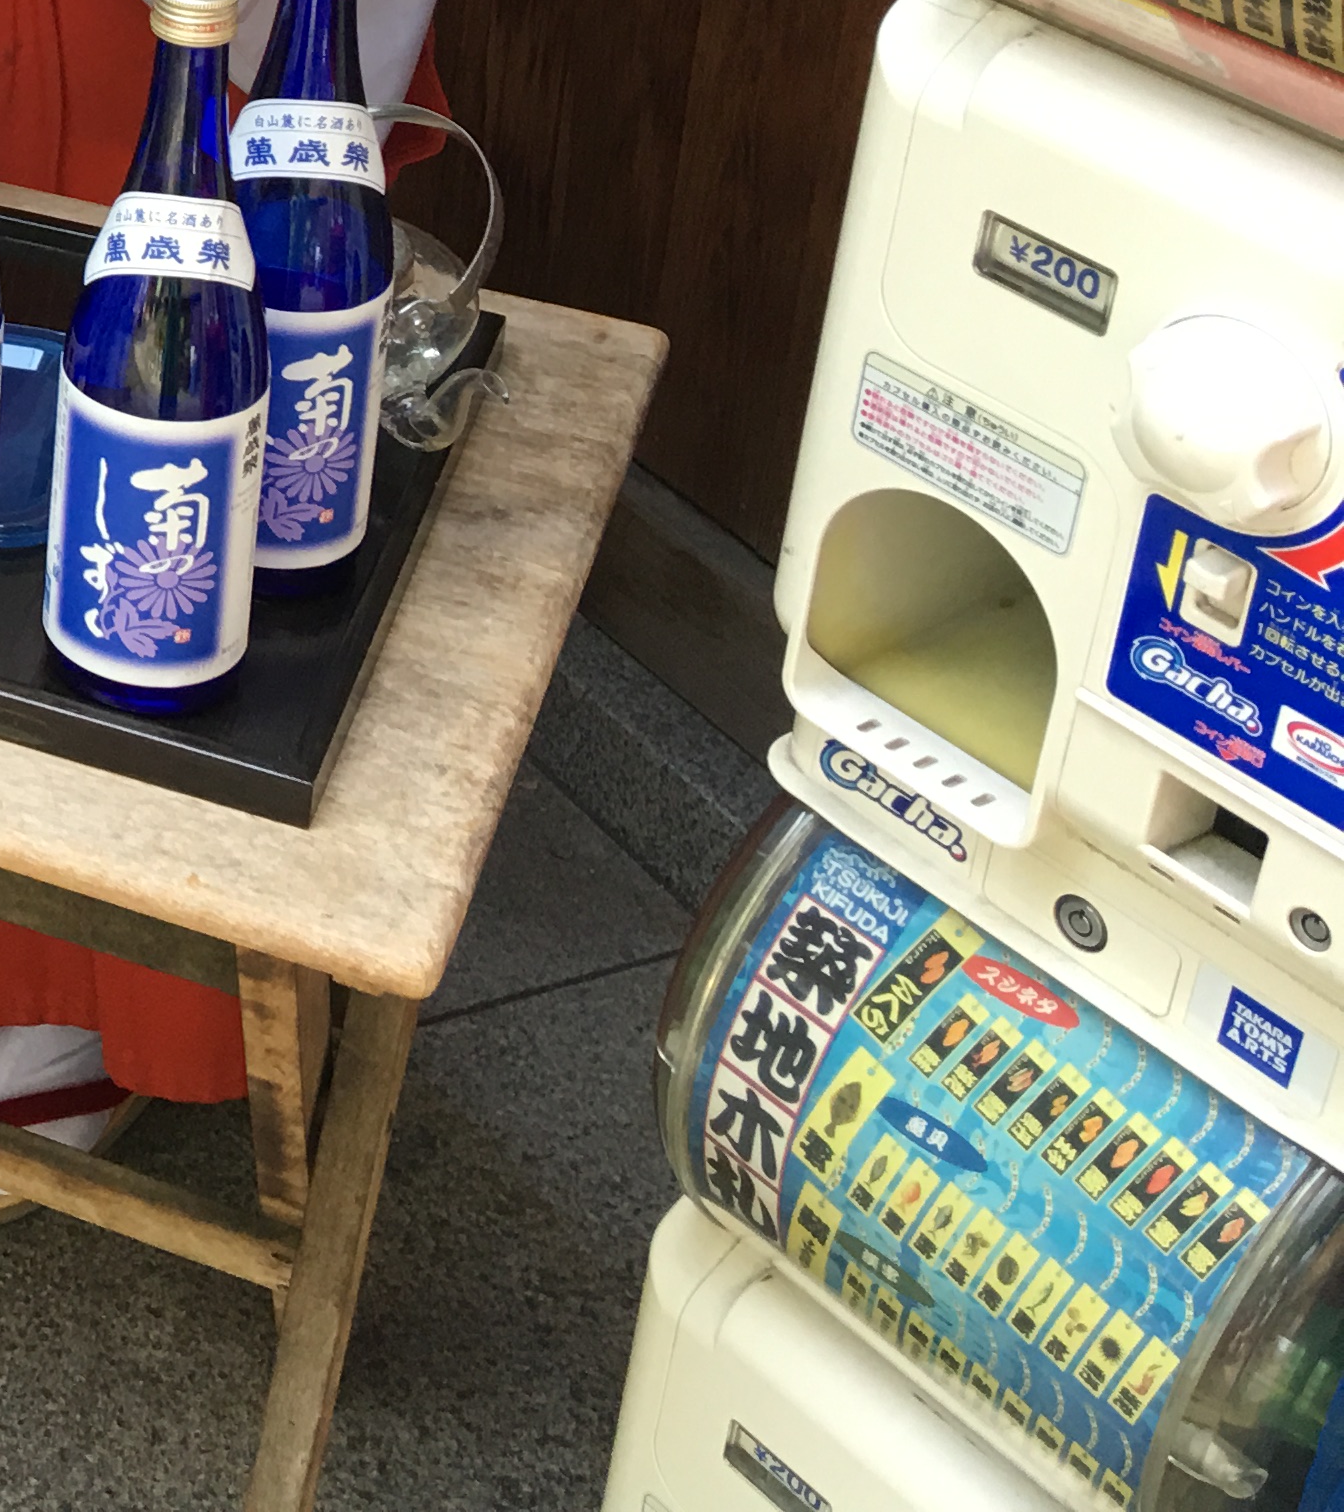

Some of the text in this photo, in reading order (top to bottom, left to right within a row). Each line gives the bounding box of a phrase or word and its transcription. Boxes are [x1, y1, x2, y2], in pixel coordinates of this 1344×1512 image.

[254, 113, 363, 133] 白山麓に名酒あり
[115, 208, 224, 229] 白山麓に名酒あり
[1009, 235, 1100, 300] ¥200
[1265, 578, 1344, 631] コインを入
[812, 880, 889, 945] KIFUDA
[827, 859, 910, 928] TSUKIJI
[861, 973, 923, 1036] いくら
[977, 965, 1058, 1015] スシネタ
[1231, 1011, 1292, 1058] TOMY
[1234, 1000, 1294, 1049] TAKARA
[1225, 1027, 1288, 1075] A.R.T.S
